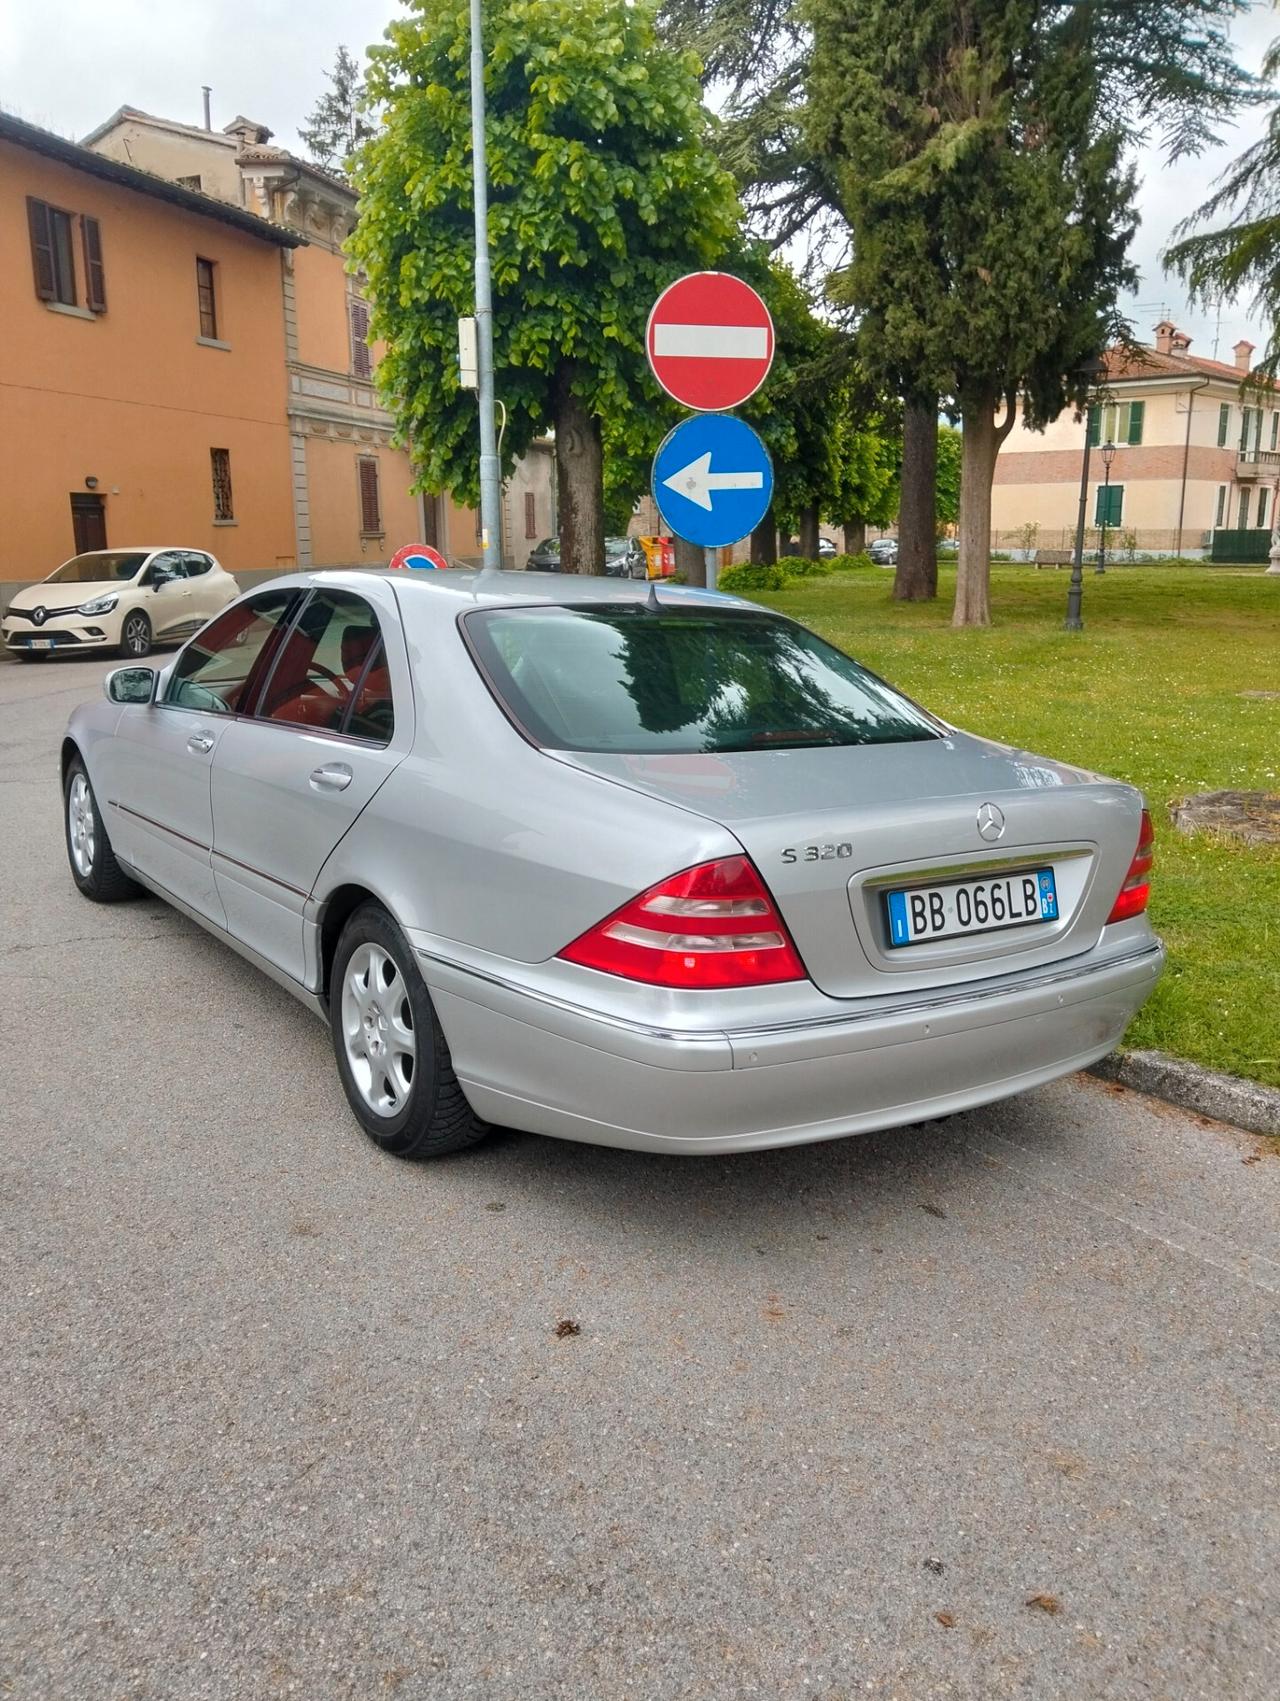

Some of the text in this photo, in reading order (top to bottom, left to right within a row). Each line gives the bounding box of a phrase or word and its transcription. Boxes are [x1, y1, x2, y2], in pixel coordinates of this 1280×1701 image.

[781, 843, 853, 864] S 320
[910, 878, 1038, 935] BB 066LB
